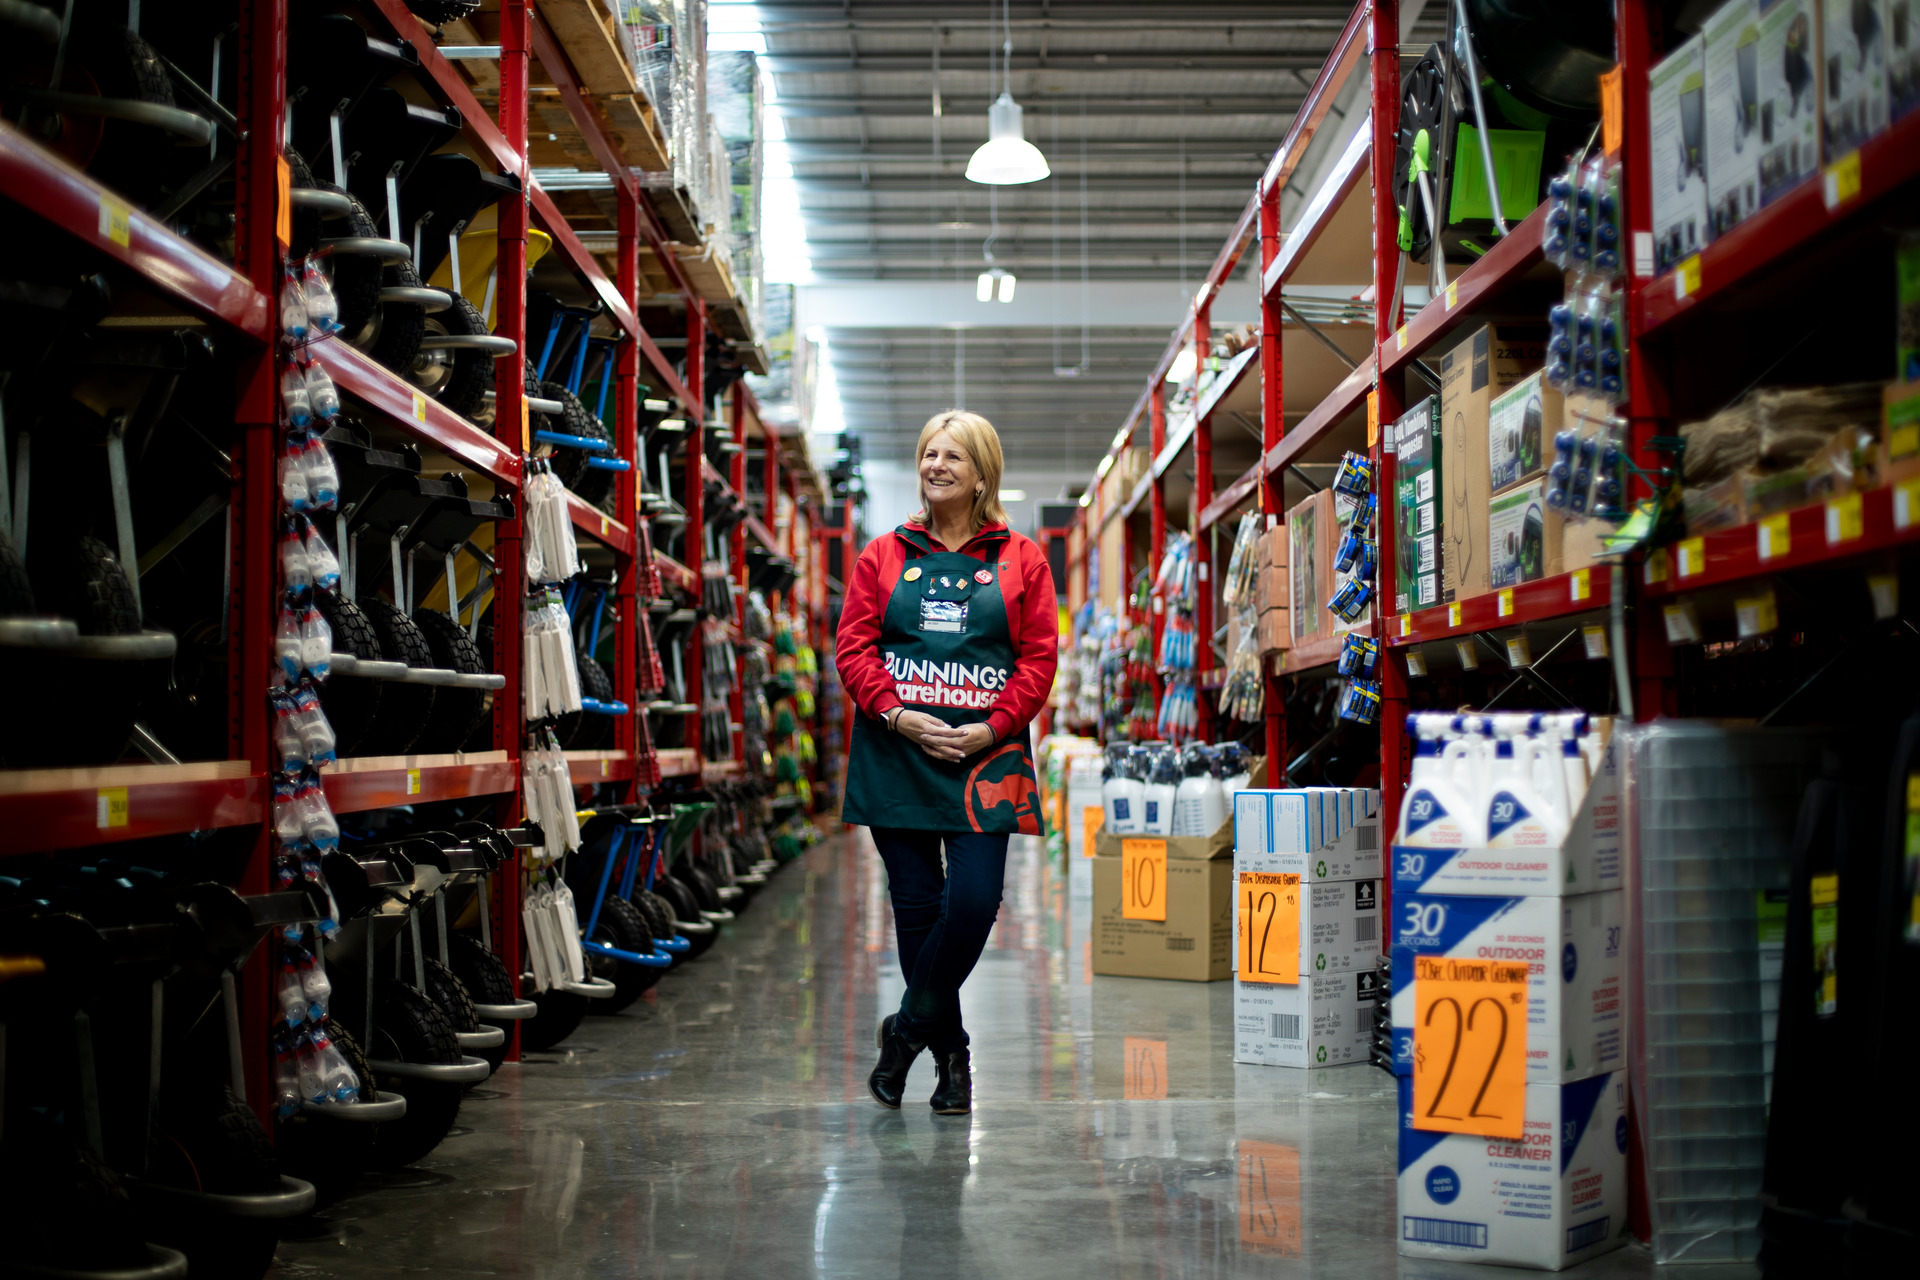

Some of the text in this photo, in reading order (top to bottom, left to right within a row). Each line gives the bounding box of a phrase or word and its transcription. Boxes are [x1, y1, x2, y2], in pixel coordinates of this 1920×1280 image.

[1497, 349, 1524, 359] 220L
[1404, 411, 1427, 437] Tumbling
[1398, 434, 1424, 461] Composter
[895, 678, 1000, 709] arehouse
[1411, 800, 1432, 815] 30
[1493, 802, 1514, 818] 30
[1397, 854, 1425, 875] 30
[1458, 861, 1548, 871] OUTDOOR CLEANER
[1132, 857, 1155, 908] 10
[1400, 902, 1446, 936] 30
[1248, 891, 1281, 976] 12
[1399, 937, 1440, 946] SECONDS
[1507, 935, 1545, 943] SECONDS
[1478, 947, 1545, 960] OUTDOOR
[1425, 997, 1508, 1121] 22
[1524, 1121, 1552, 1130] CONDS
[1487, 1145, 1552, 1161] CLEANER
